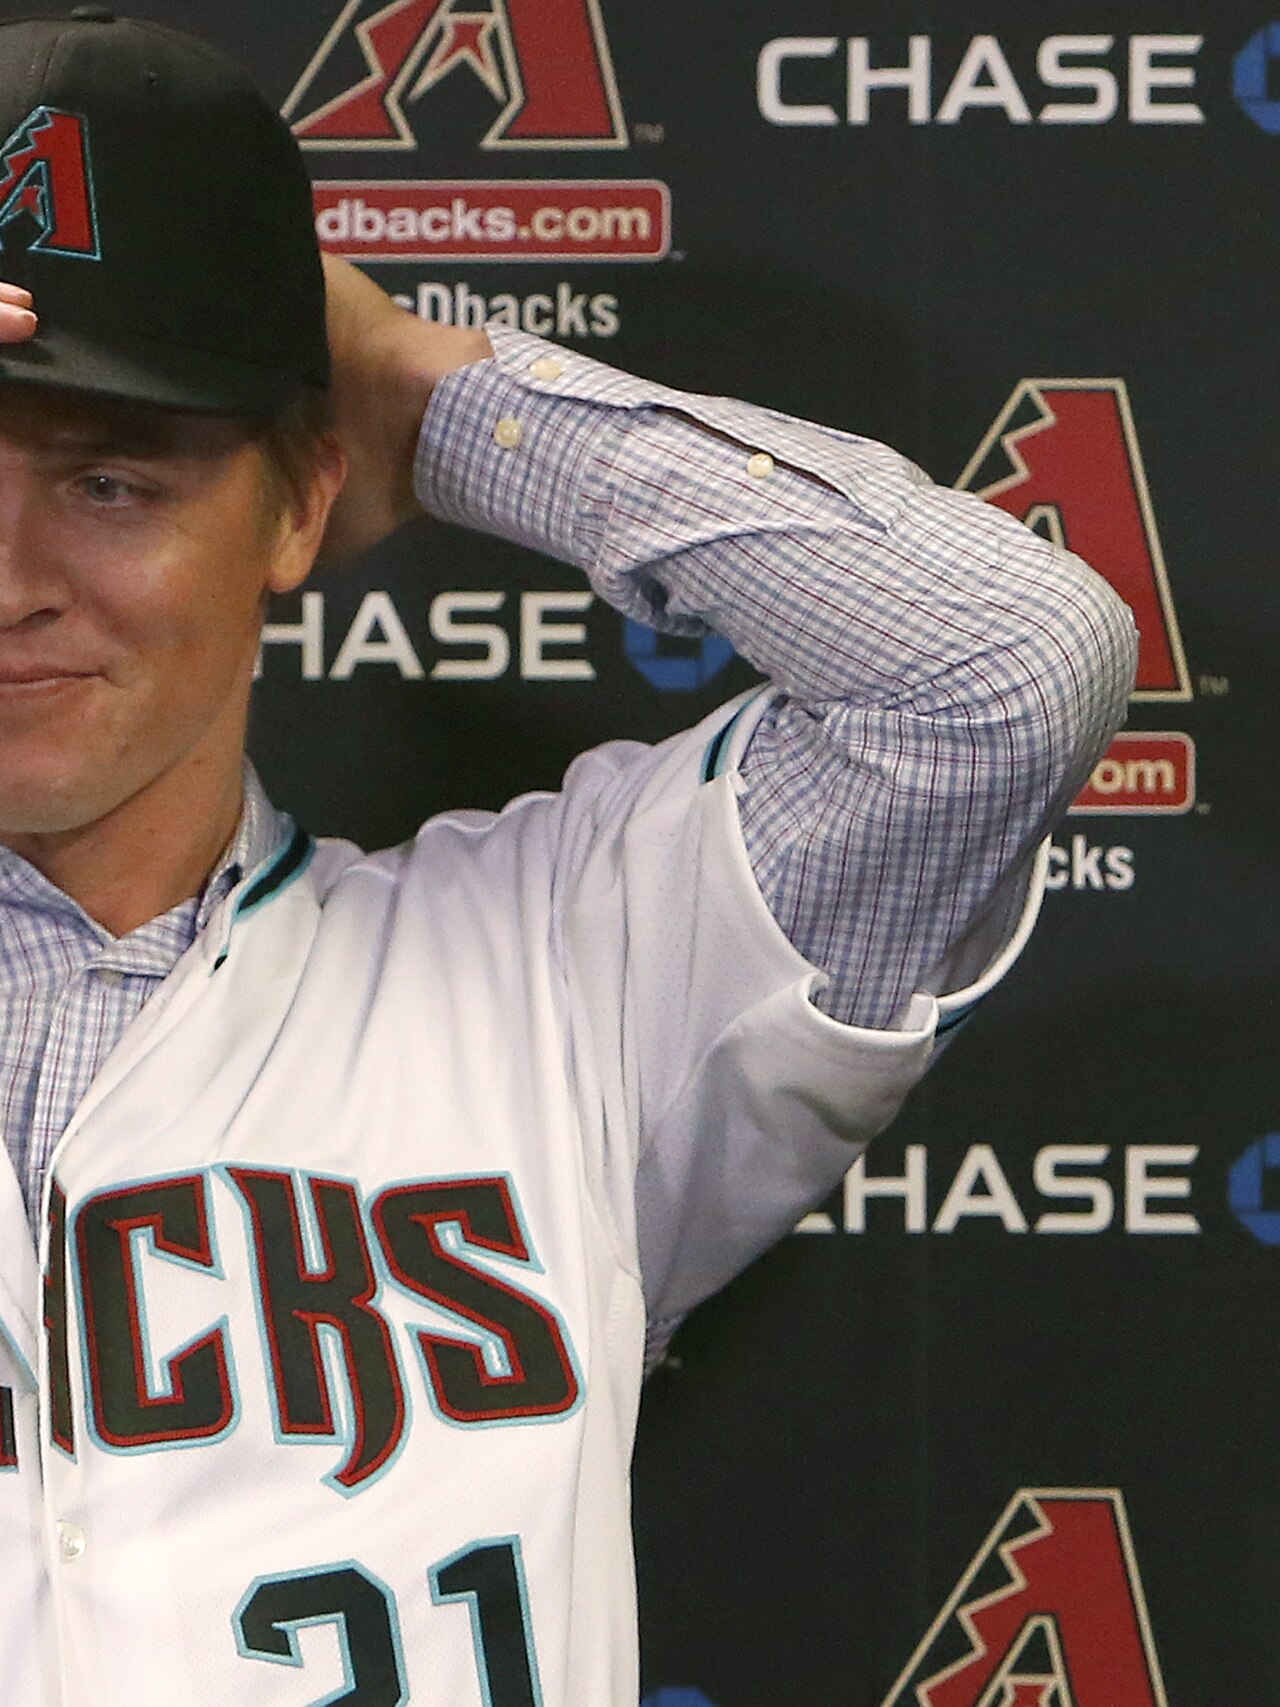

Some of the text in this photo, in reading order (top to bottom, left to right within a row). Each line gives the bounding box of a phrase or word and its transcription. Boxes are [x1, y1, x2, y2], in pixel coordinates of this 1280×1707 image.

[756, 35, 1205, 125] CHASE
[315, 200, 651, 242] dbacks.com
[793, 1143, 1202, 1235] HASE
[230, 1533, 545, 1707] 21
